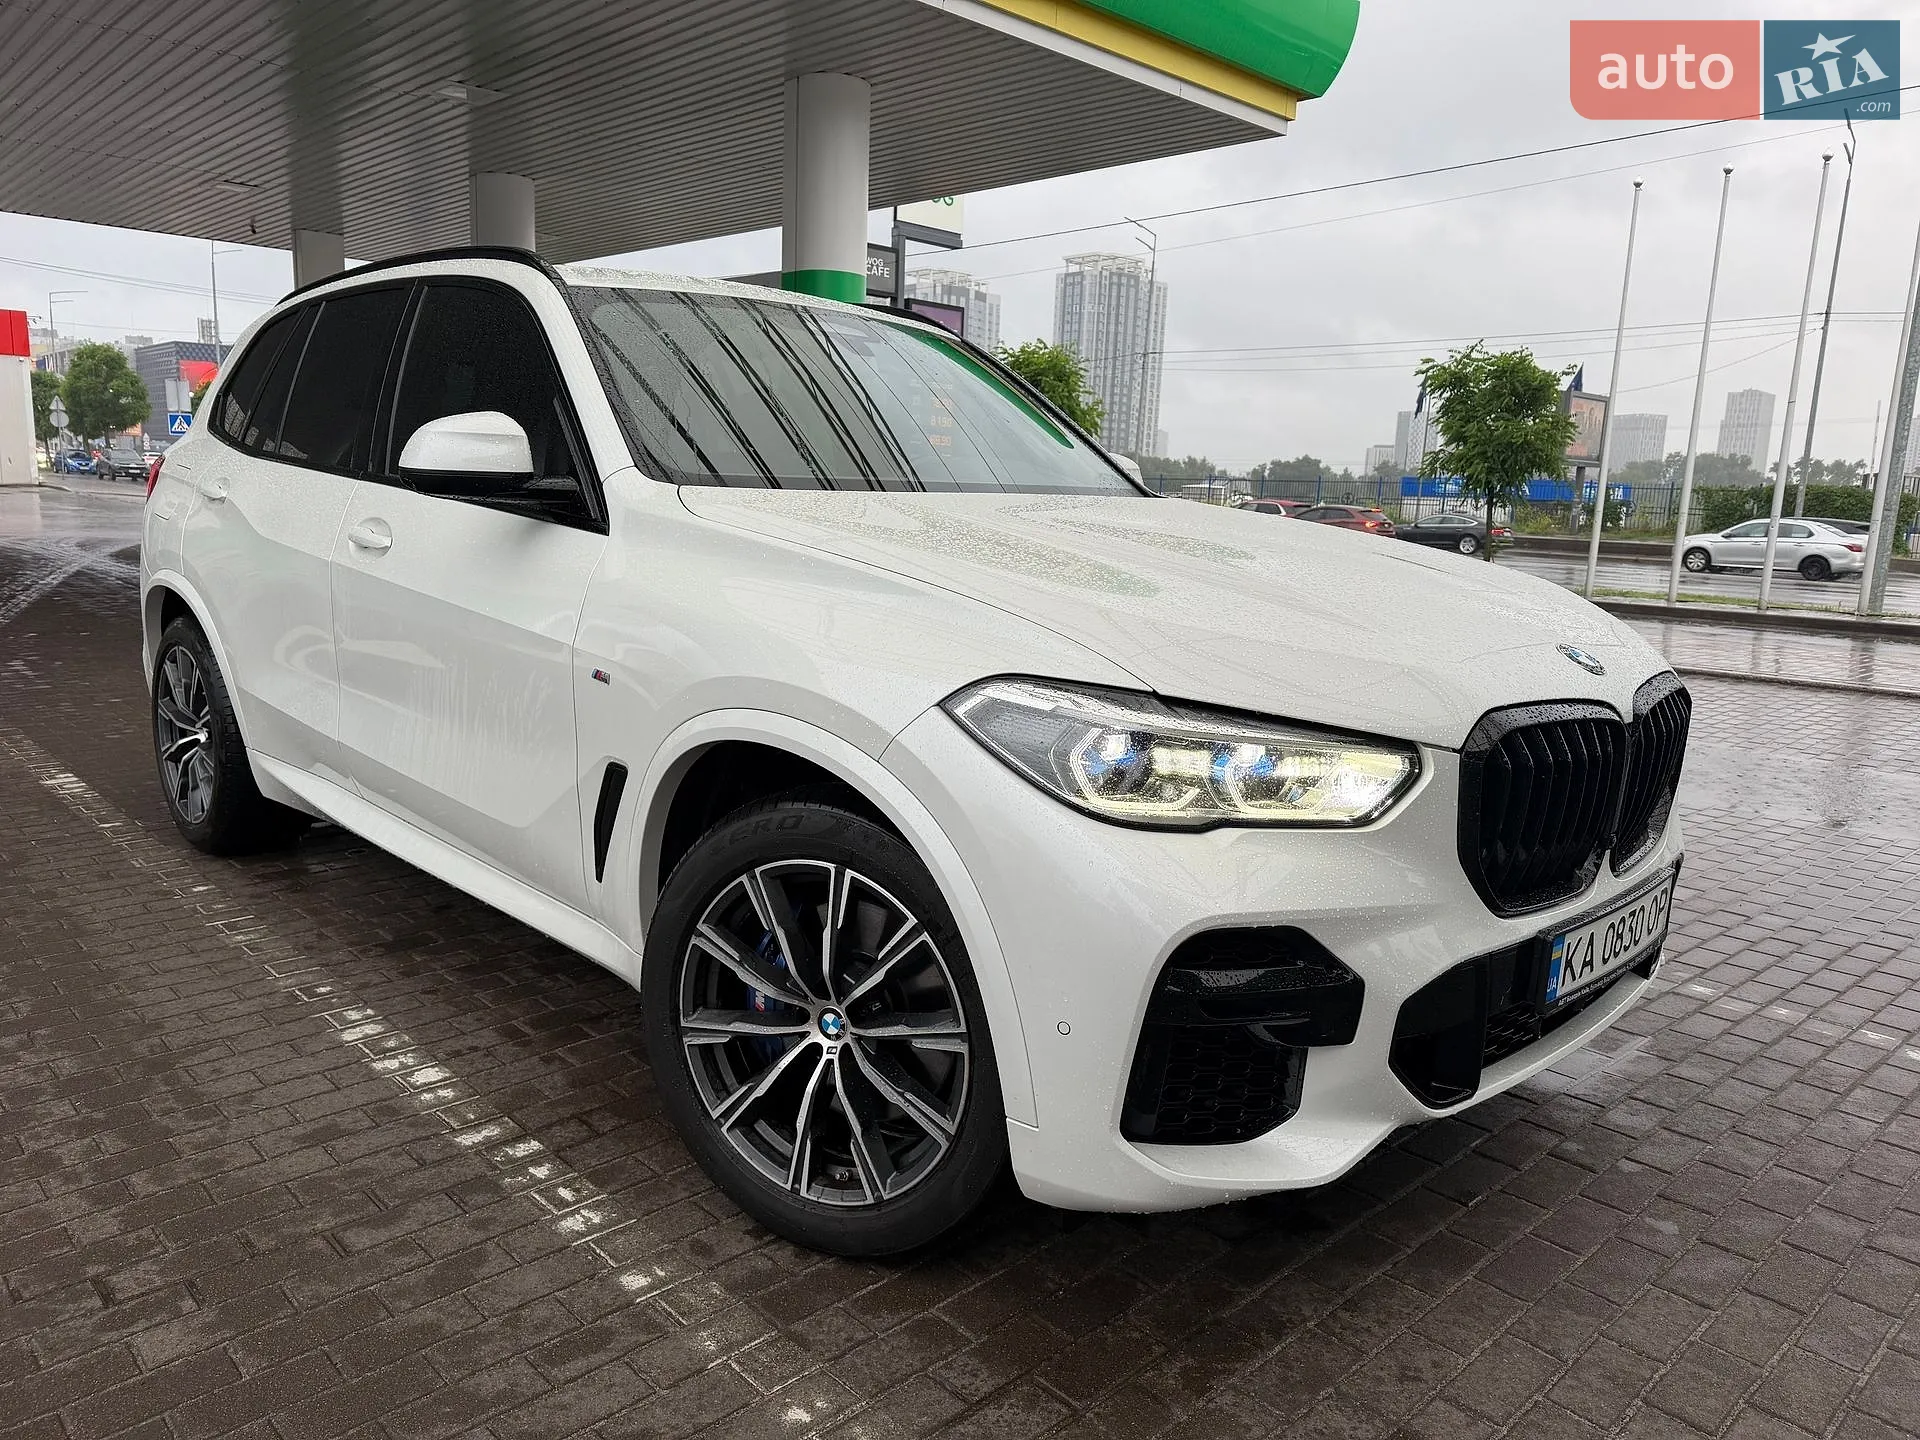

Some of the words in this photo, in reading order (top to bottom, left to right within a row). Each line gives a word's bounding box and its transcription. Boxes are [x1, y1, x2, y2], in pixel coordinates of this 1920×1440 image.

[866, 264, 890, 278] CAFE
[1561, 931, 1595, 988] KA
[1602, 904, 1646, 965] 0830
[1646, 886, 1668, 936] OP
[1547, 975, 1558, 993] UA
